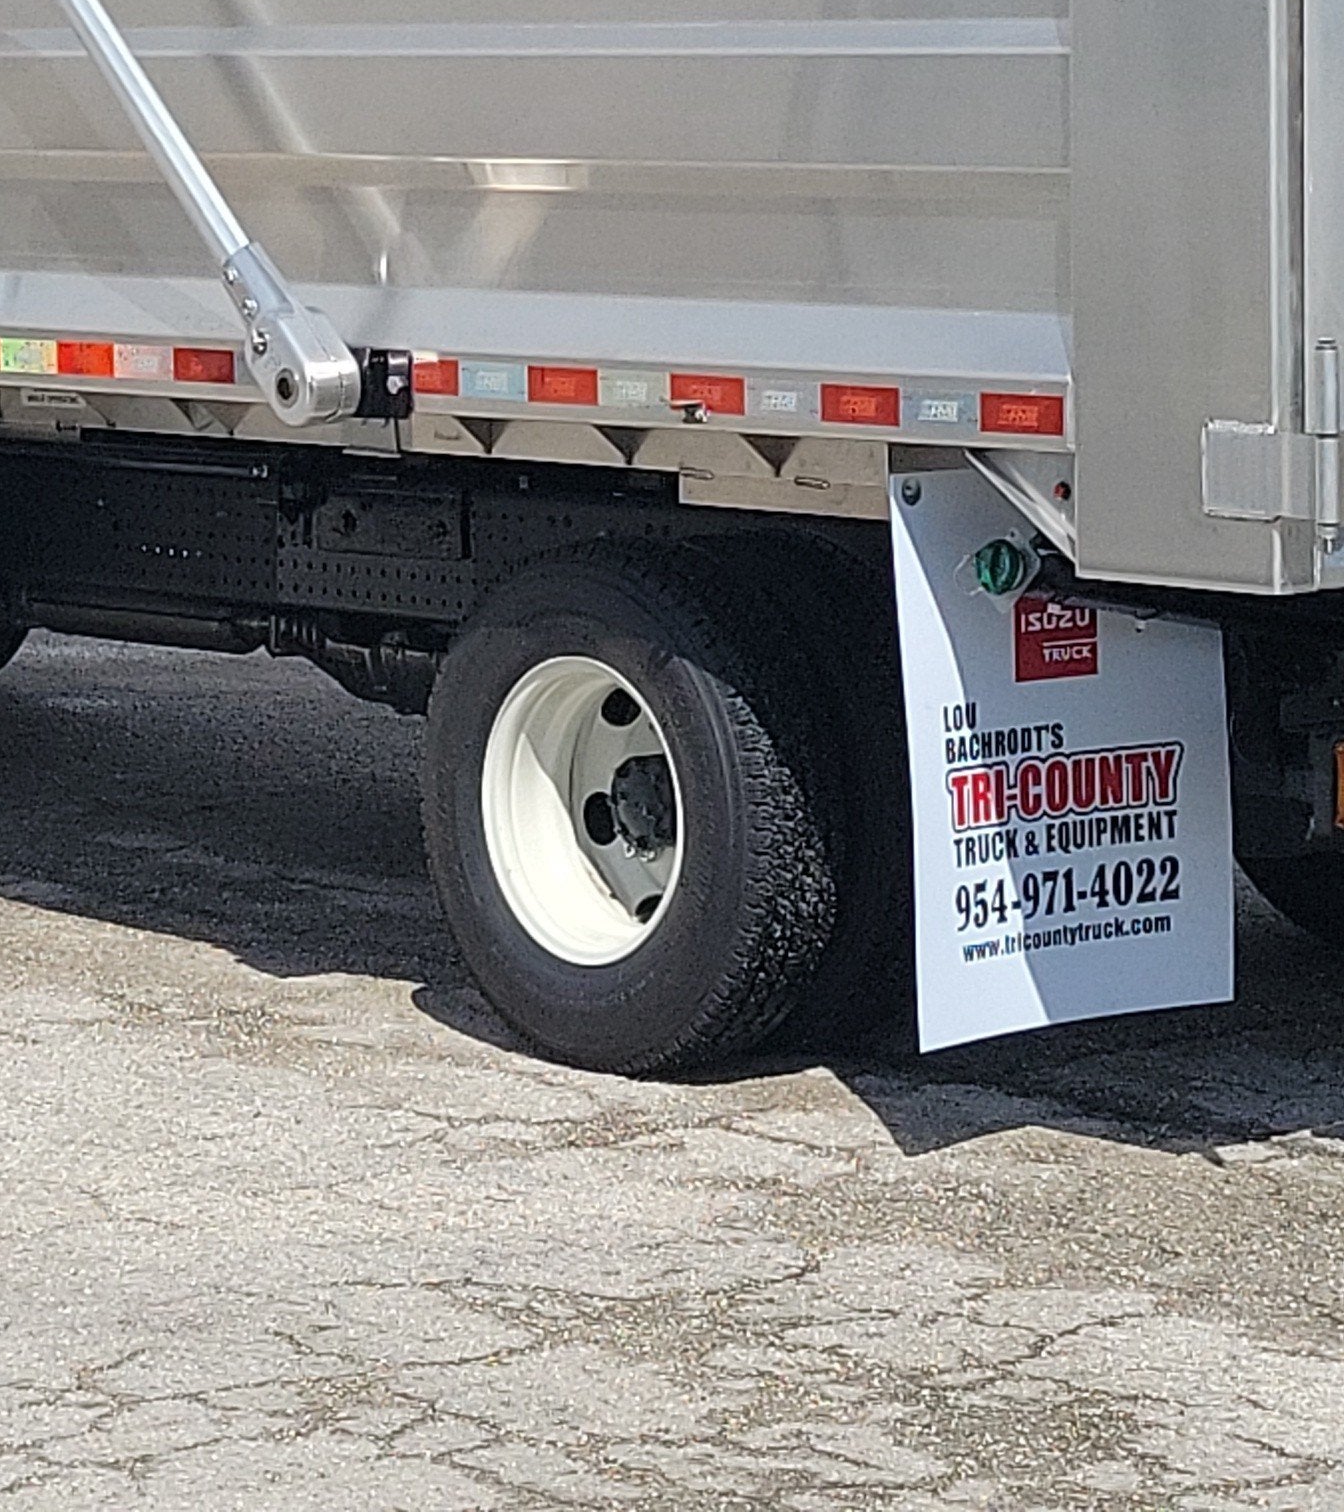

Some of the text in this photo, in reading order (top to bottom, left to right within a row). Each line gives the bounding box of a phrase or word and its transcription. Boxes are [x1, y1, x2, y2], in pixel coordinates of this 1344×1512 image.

[1020, 607, 1090, 634] ISUZU
[1042, 644, 1093, 664] TRUCK
[943, 701, 976, 733] LOU
[944, 722, 1065, 765] BACHRODT'S
[948, 746, 1180, 830] TRI-COUNTY
[953, 809, 1178, 868] TRUCK & EQUIPMENT
[955, 855, 1181, 932] 954-971-4022
[962, 915, 1172, 963] www.tricountytruck.com
